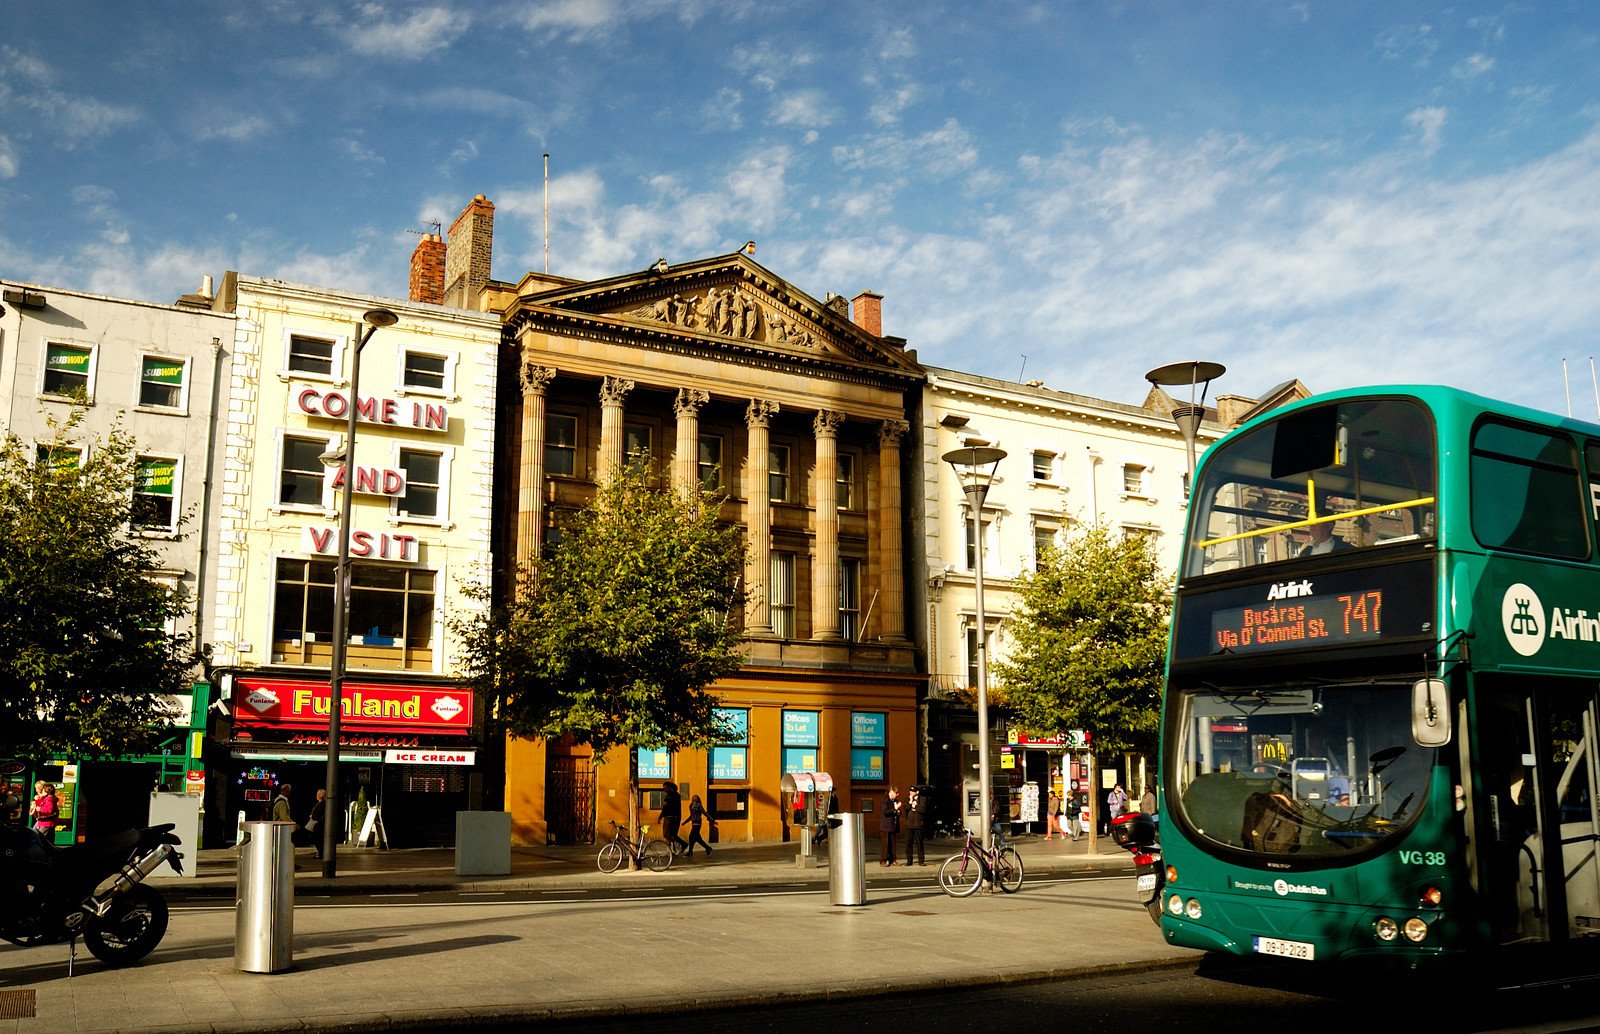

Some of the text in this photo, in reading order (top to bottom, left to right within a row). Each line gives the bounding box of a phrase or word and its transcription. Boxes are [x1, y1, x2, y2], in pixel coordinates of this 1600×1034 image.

[49, 355, 89, 364] SUBWAY
[144, 366, 182, 377] SUBWAY
[298, 389, 444, 428] COME IN
[139, 475, 174, 486] UBWAY
[332, 461, 402, 493] AND
[1267, 580, 1313, 600] Airlink
[1338, 591, 1382, 633] 747
[1550, 607, 1600, 642] Airlin
[1217, 630, 1238, 648] Via
[1257, 622, 1304, 643] Connell
[1308, 618, 1329, 638] St.
[293, 689, 420, 719] Funland
[784, 714, 810, 723] Offices
[853, 716, 878, 725] Offices
[785, 723, 807, 732] To Let
[854, 725, 875, 734] To Let
[396, 753, 466, 763] ICE CREAM
[649, 767, 668, 776] 1300
[726, 768, 744, 777] 1300
[852, 769, 882, 778] 618 1300
[1399, 851, 1446, 866] VG 38
[1288, 884, 1327, 895] Dublin Bus
